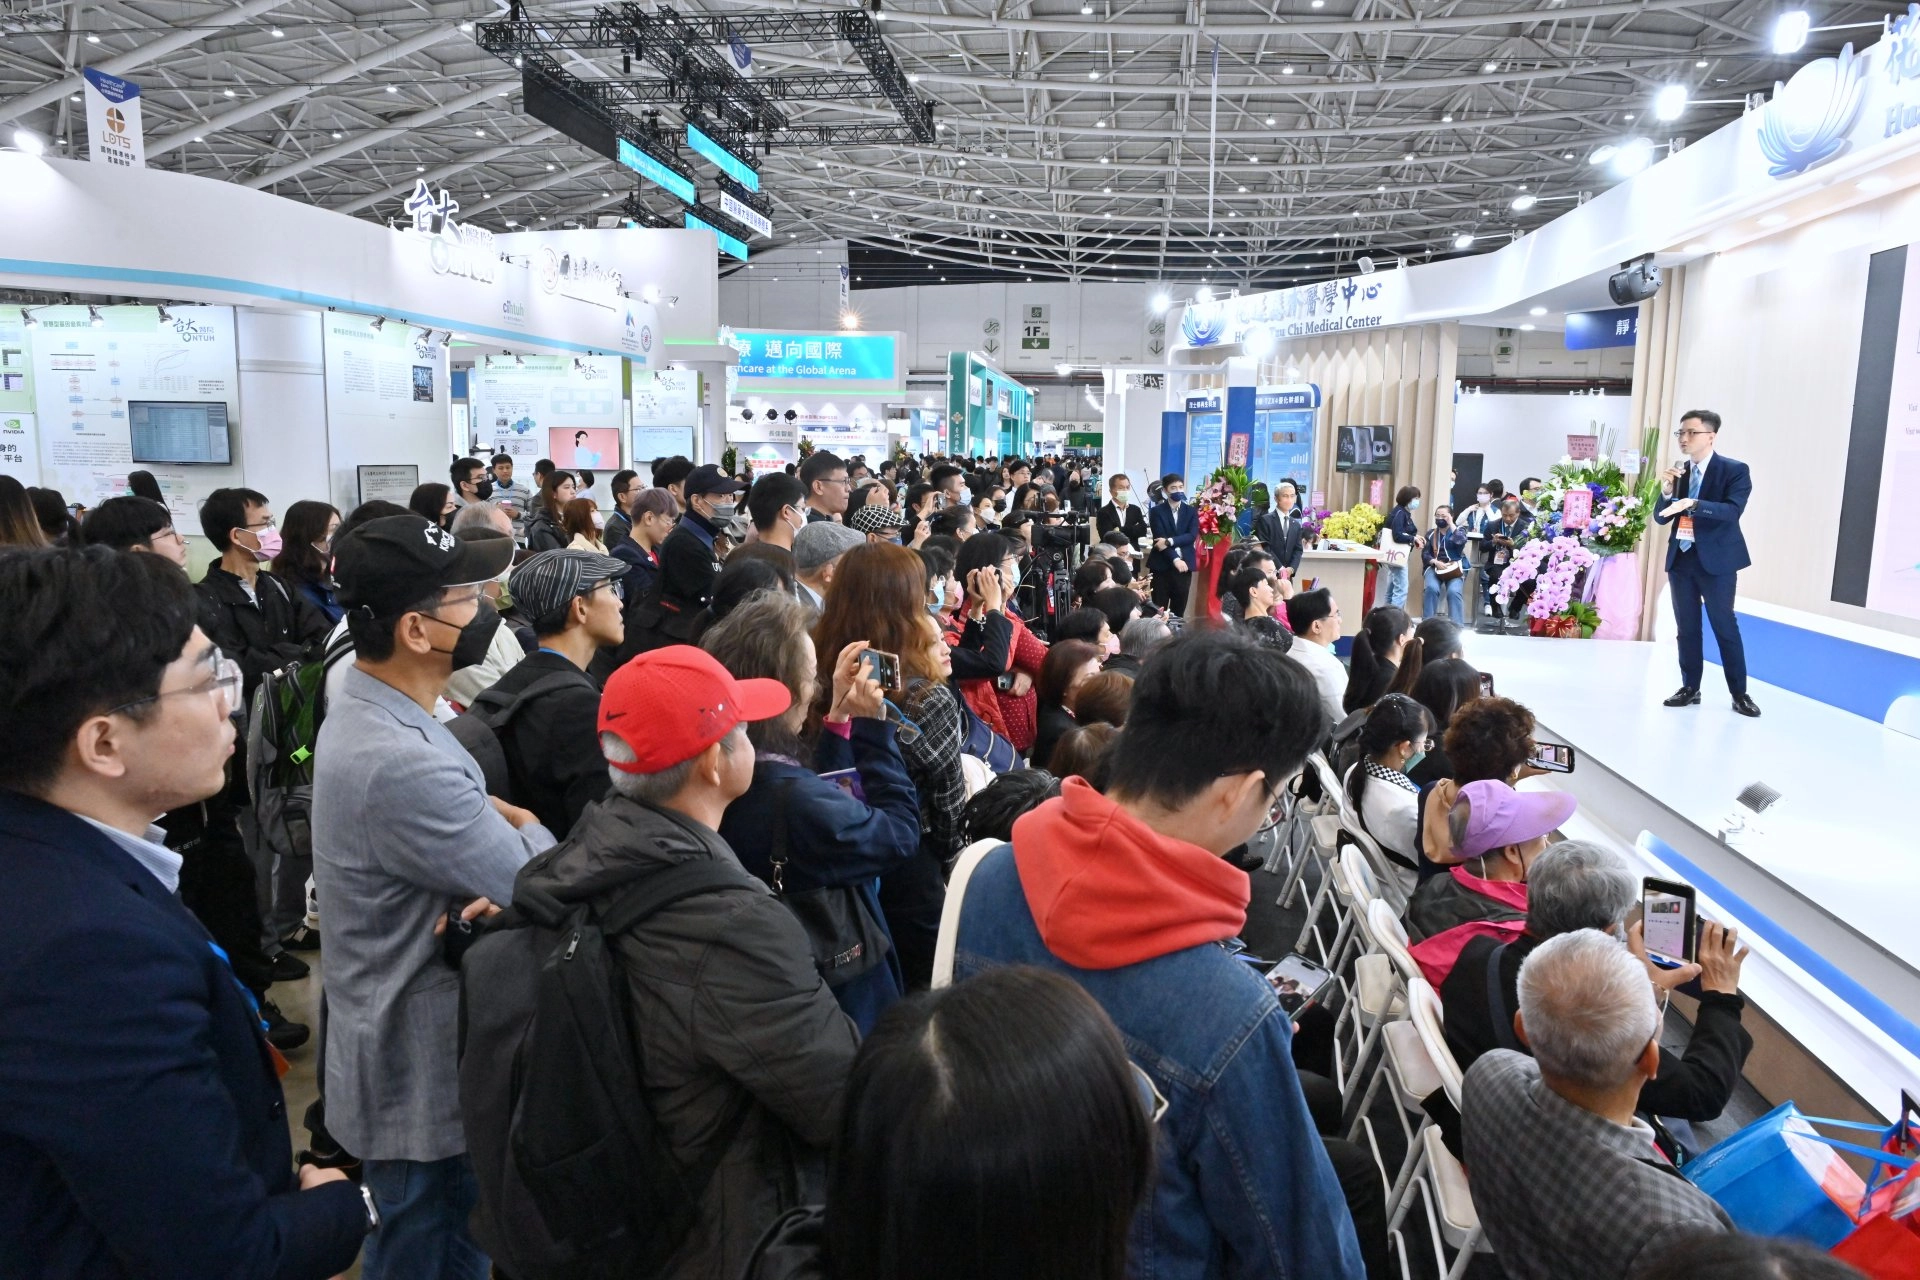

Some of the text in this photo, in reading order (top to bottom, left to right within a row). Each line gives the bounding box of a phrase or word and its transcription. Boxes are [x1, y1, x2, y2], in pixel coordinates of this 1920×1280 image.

[1287, 322, 1303, 336] Chi
[1305, 316, 1343, 335] Medical
[1345, 313, 1382, 329] Center
[1024, 326, 1041, 337] 1F
[192, 334, 215, 342] NTUH
[765, 340, 843, 360] 邁向國際
[766, 365, 775, 374] at
[777, 364, 794, 375] the
[795, 364, 827, 375] Global
[828, 366, 857, 376] Arena
[1052, 423, 1076, 431] North
[1082, 423, 1092, 432] 北
